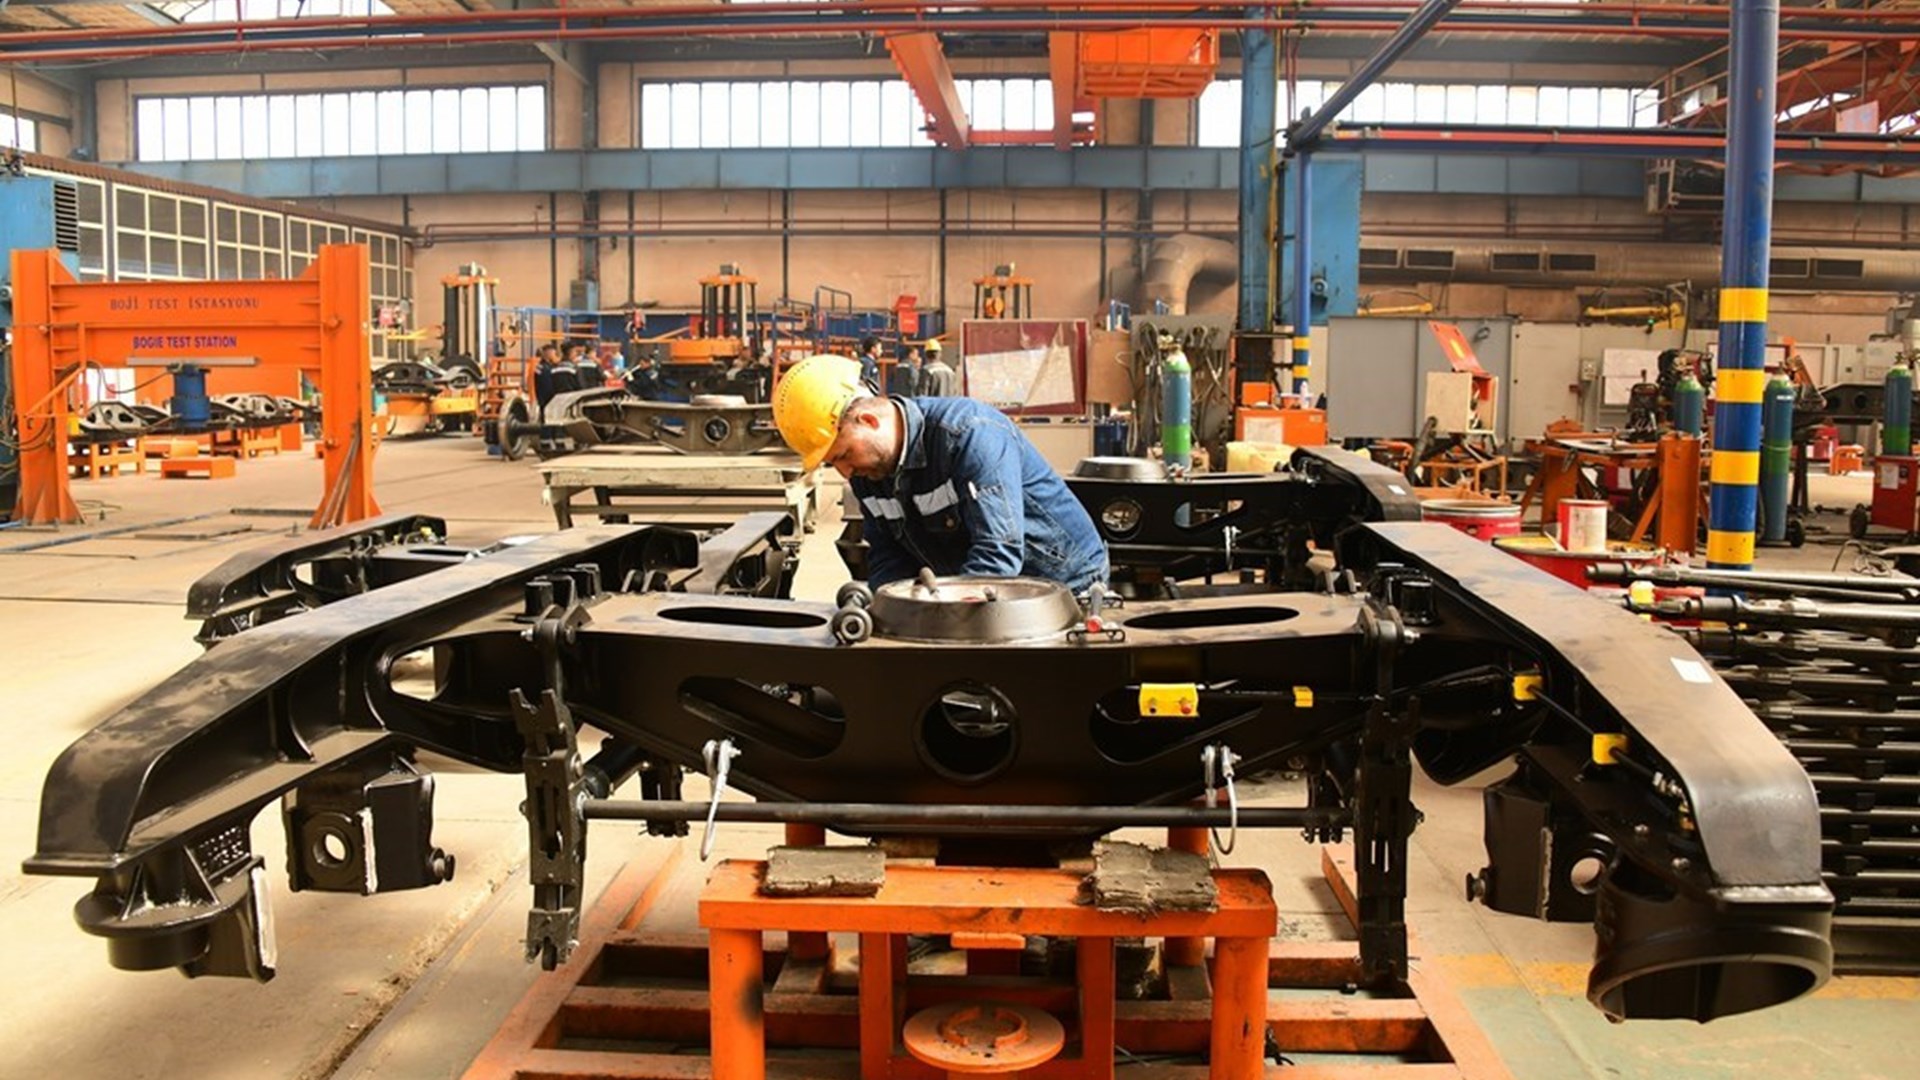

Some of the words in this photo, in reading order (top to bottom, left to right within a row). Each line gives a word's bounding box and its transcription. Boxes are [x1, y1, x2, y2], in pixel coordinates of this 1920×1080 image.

[148, 298, 178, 309] TEST
[189, 296, 259, 309] İSTASYONU
[133, 336, 163, 349] BOGIE
[167, 335, 192, 348] TEST
[195, 335, 237, 348] STATION
